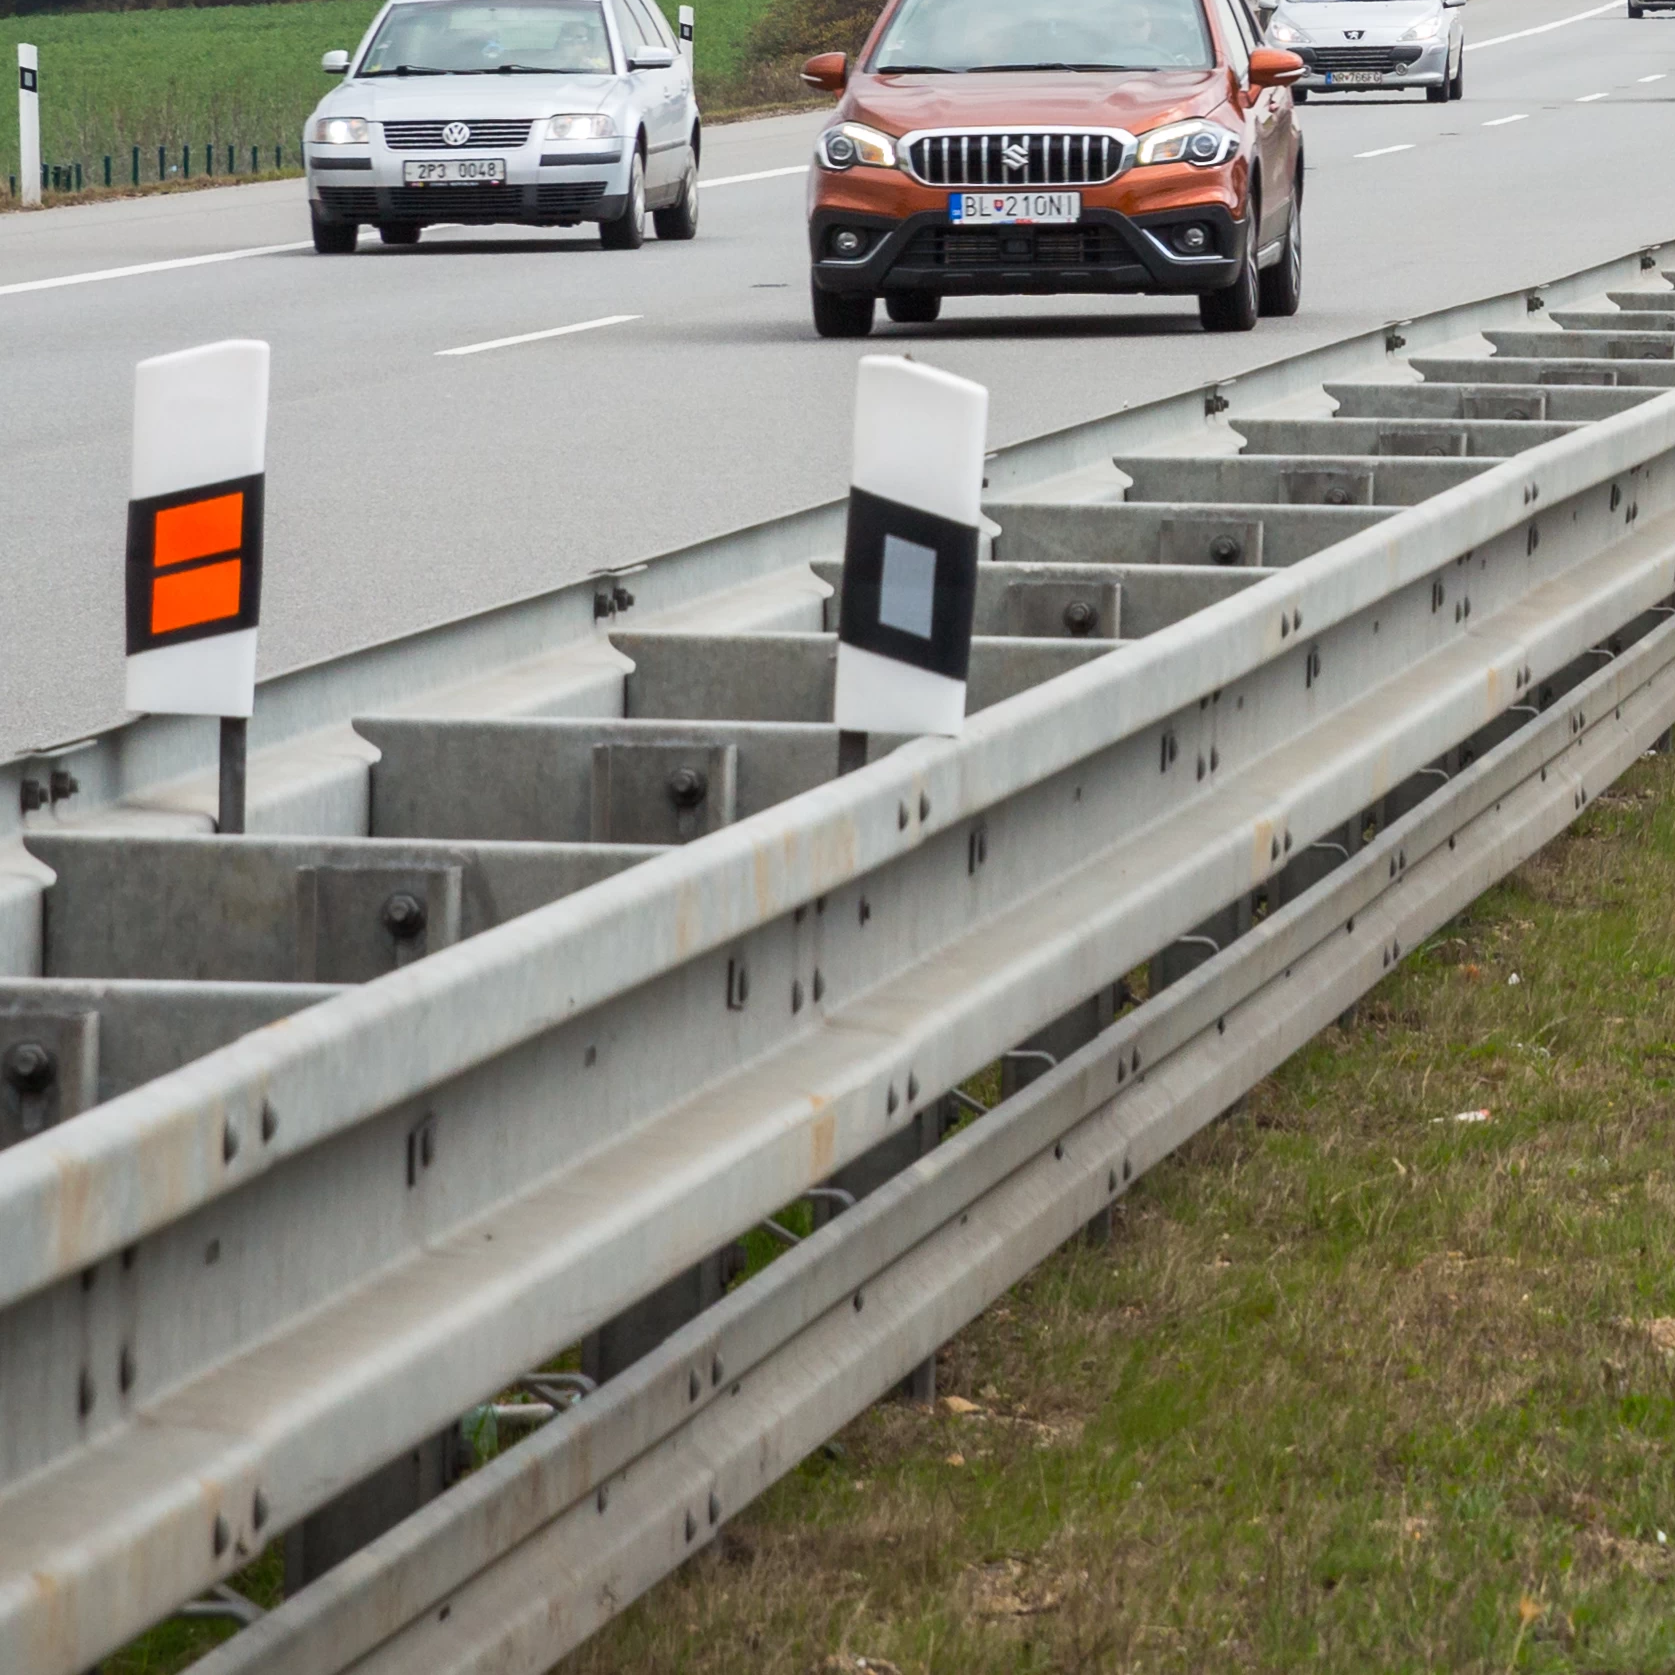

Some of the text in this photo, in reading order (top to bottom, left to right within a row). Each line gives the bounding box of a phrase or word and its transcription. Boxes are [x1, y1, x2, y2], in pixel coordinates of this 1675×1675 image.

[417, 162, 497, 179] 2P3 0048
[964, 195, 1072, 217] BL 210NI
